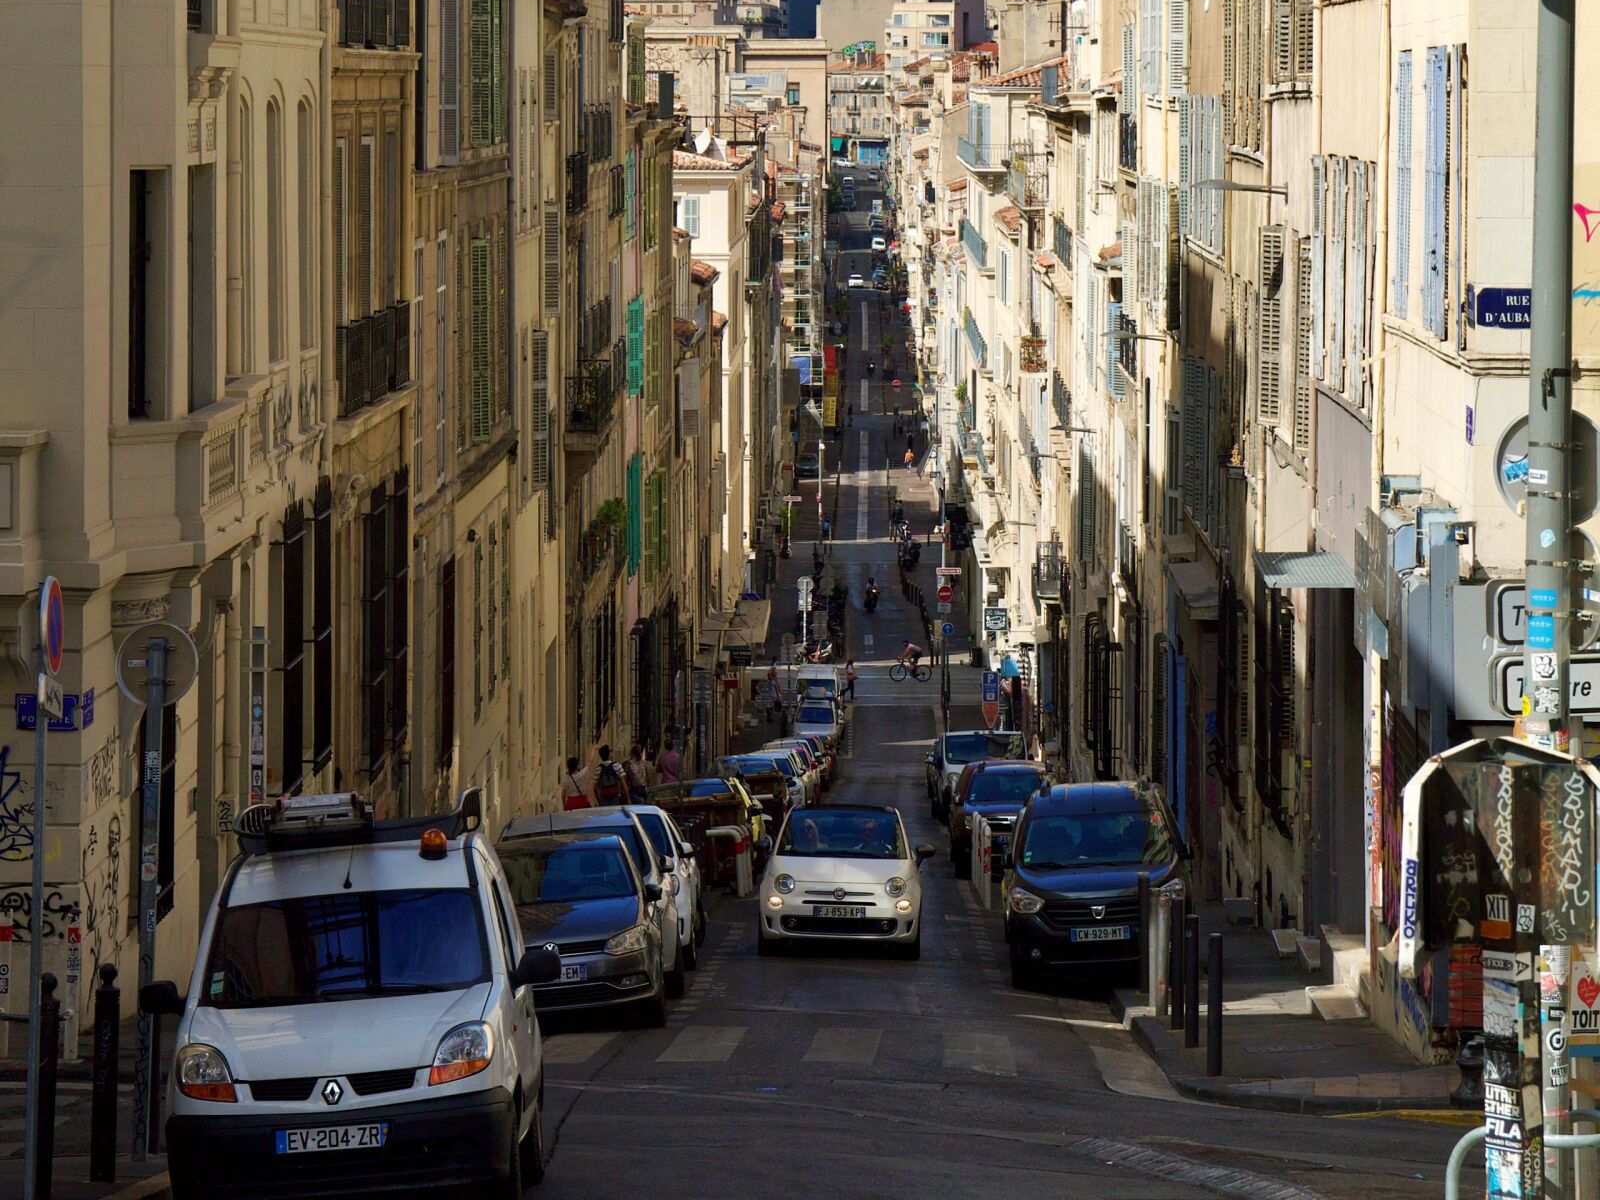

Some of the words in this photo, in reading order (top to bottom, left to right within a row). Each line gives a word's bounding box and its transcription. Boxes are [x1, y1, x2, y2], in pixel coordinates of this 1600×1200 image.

[1506, 295, 1530, 306] RUE
[1485, 313, 1531, 323] D'AUBA
[1487, 895, 1507, 920] XIT
[1485, 1084, 1517, 1105] UTAH
[287, 1127, 379, 1151] EV-204-ZR
[1485, 1117, 1522, 1141] FILA
